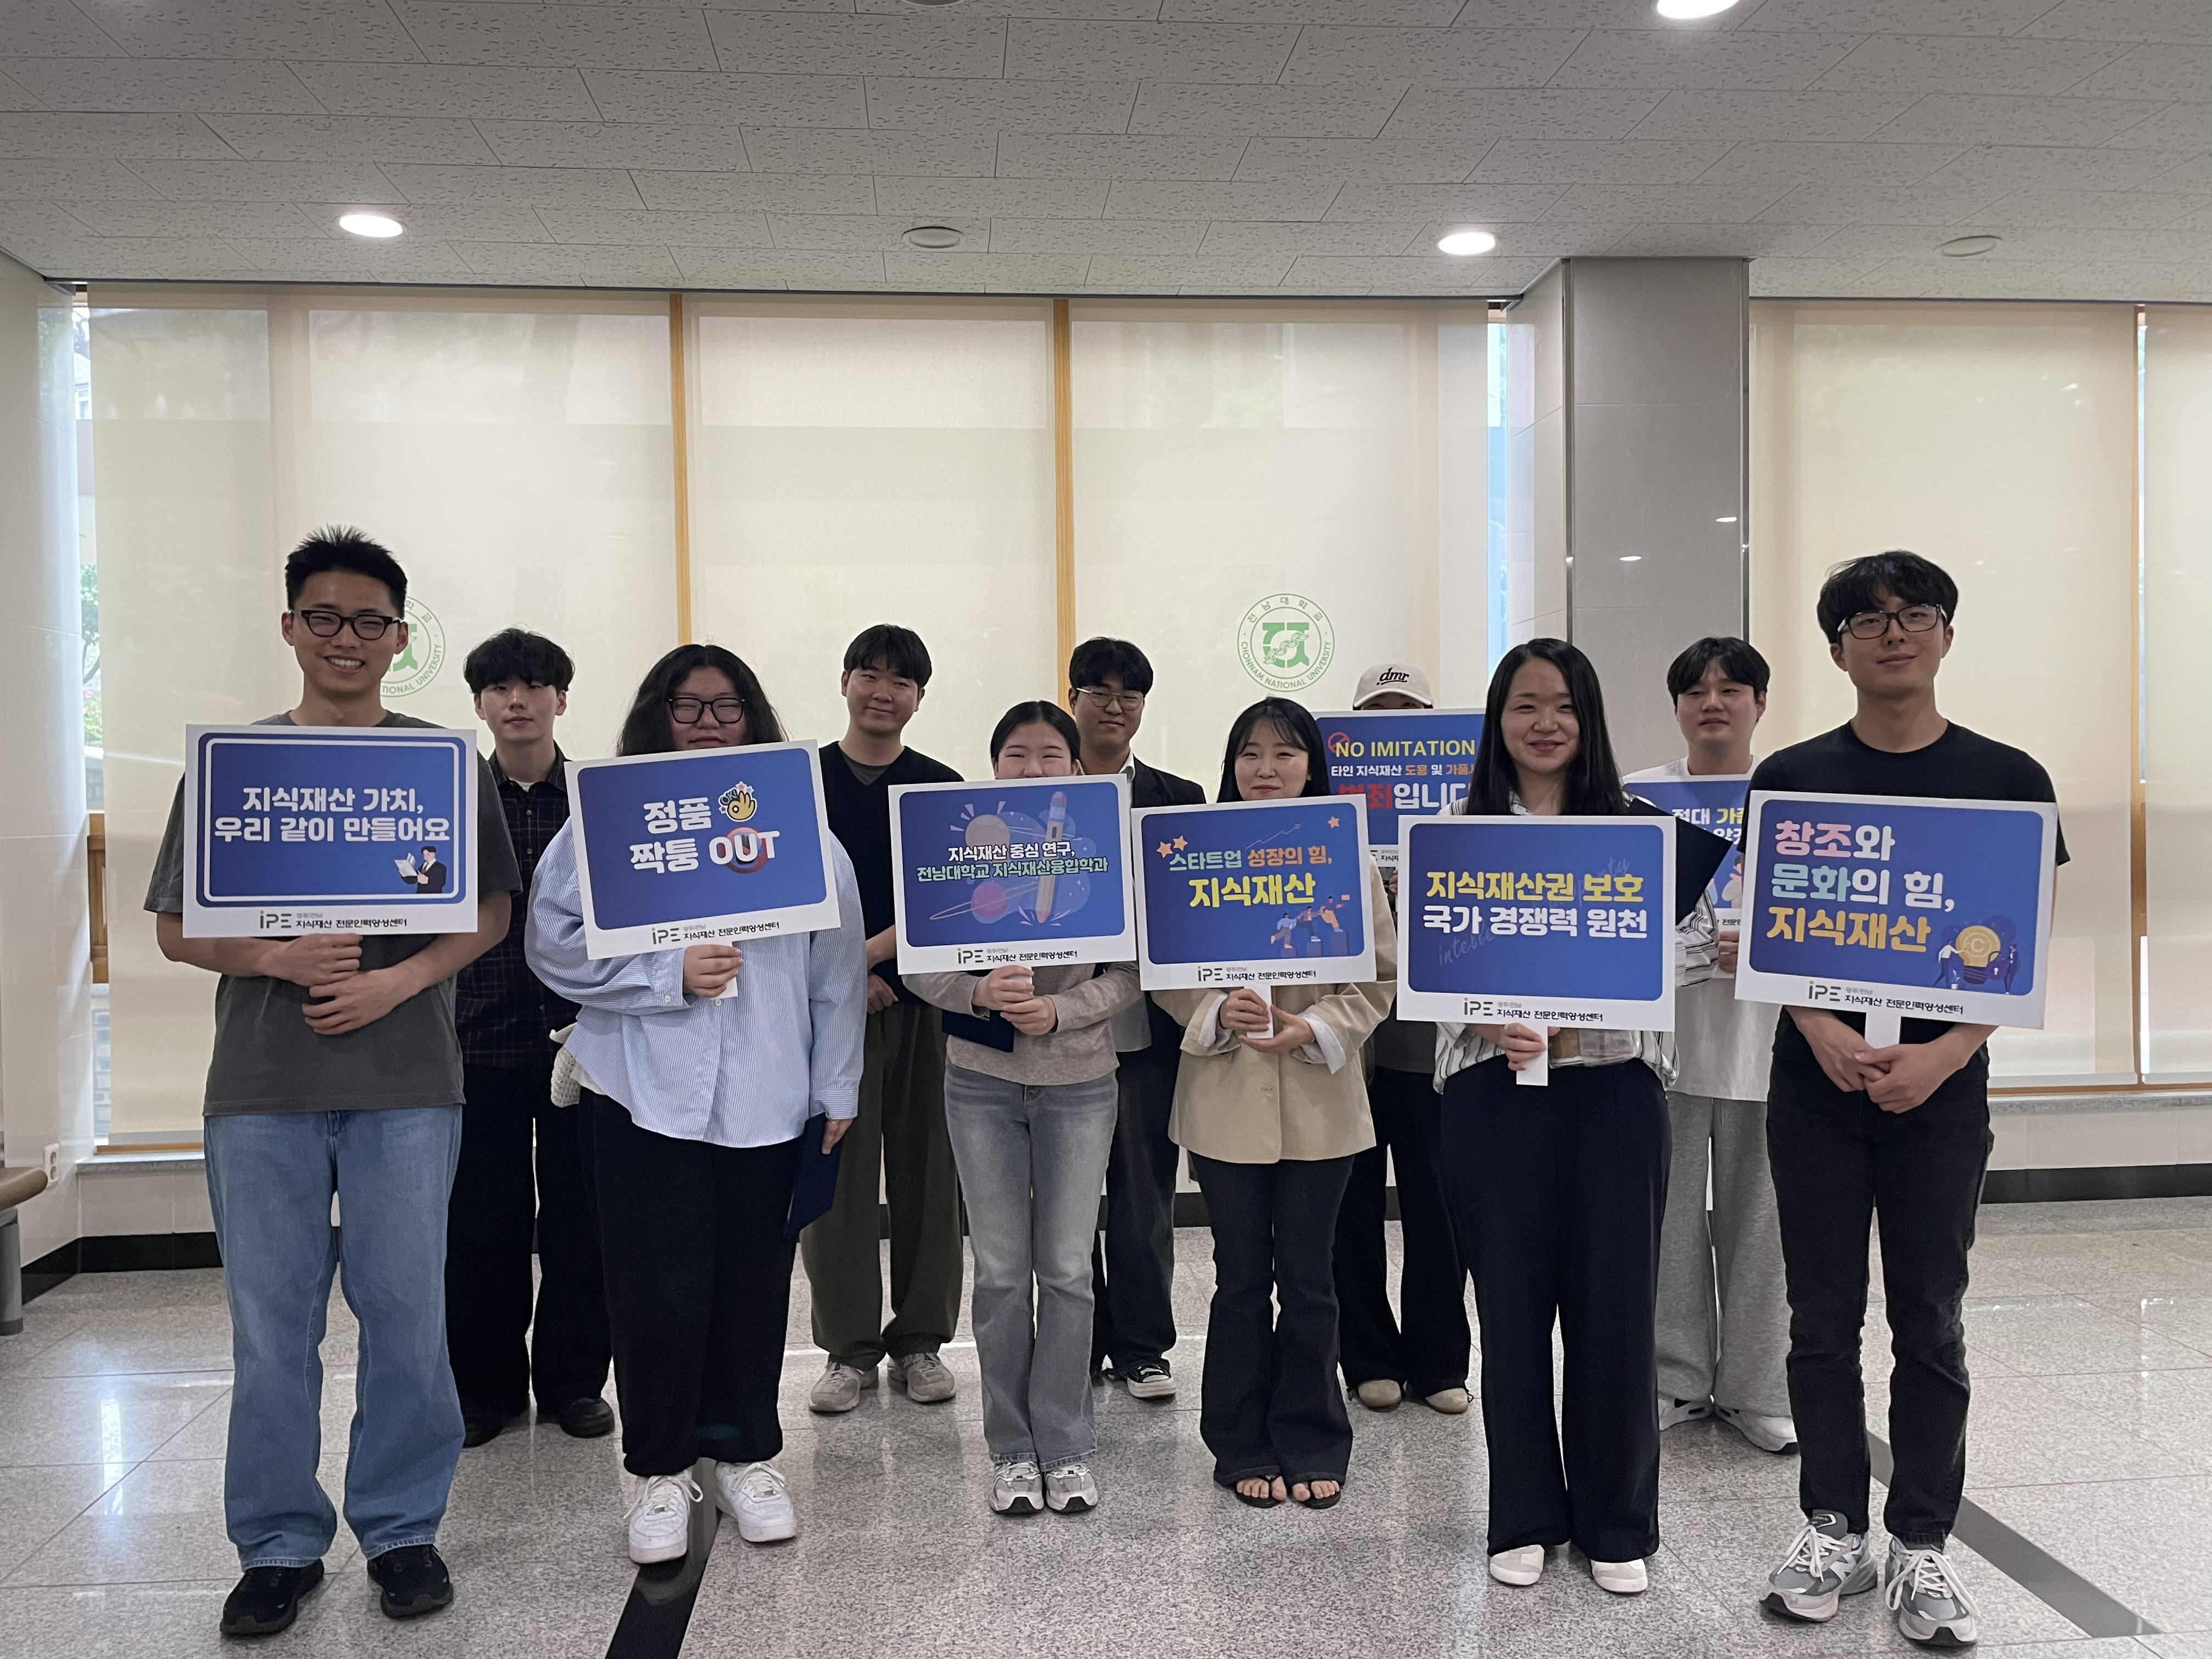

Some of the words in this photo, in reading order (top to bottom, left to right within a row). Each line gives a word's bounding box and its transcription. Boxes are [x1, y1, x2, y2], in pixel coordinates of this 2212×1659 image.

[382, 683, 415, 694] TIONAL
[415, 644, 442, 685] UNIVERSITY
[1241, 641, 1265, 680] CHONNAM
[1265, 678, 1306, 689] NATIONAL
[1307, 641, 1331, 680] UNIVERSITY
[1379, 667, 1409, 682] dmr
[1336, 741, 1365, 758] NO
[1372, 740, 1475, 757] IMITATION
[1331, 765, 1353, 777] 타인
[1356, 765, 1402, 777] 지식재산
[1431, 764, 1443, 776] 및
[243, 787, 356, 812] 지식재산
[363, 788, 424, 814] 가치,
[643, 797, 712, 834] 정품
[215, 817, 270, 843] 우리
[280, 817, 334, 843] 같이
[344, 817, 450, 843] 만들어요
[1774, 820, 1896, 862] 창조와
[629, 837, 699, 874] 짝퉁
[708, 831, 780, 865] OUT
[948, 843, 1007, 862] 지식재산
[1009, 843, 1039, 860] 중심
[1042, 841, 1075, 858] 연구,
[1169, 850, 1242, 871] 스타트업
[1247, 846, 1302, 867] 성장의
[1307, 845, 1333, 865] 힘,
[917, 864, 990, 882] 전남대학교
[992, 857, 1108, 878] 지식재산융합학과
[1188, 872, 1316, 908] 지식재산
[1426, 871, 1575, 901] 지식재산권
[1582, 873, 1644, 902] 보호
[1771, 862, 1891, 906] 문화의
[1903, 870, 1955, 912] 힘,
[295, 920, 332, 929] 지식재산
[336, 918, 407, 929] 전문인력양성센터
[684, 930, 715, 940] 지식재산
[718, 922, 780, 937] 전문인력양성센터
[1423, 904, 1483, 934] 국가
[1489, 906, 1578, 937] 경쟁력
[1587, 908, 1647, 939] 원천
[1766, 906, 1931, 953] 지식재산
[987, 955, 1016, 963] 지식재산
[1019, 950, 1077, 961] 전문인력양성센터
[1226, 972, 1255, 981] 지식재산
[1257, 970, 1316, 980] 전문인력양성센터
[1497, 1009, 1531, 1018] 지식재산
[1534, 1011, 1603, 1022] 전문인력양성센터
[1844, 995, 1883, 1007] 지식재산
[1886, 998, 1963, 1014] 전문인력양성센터
